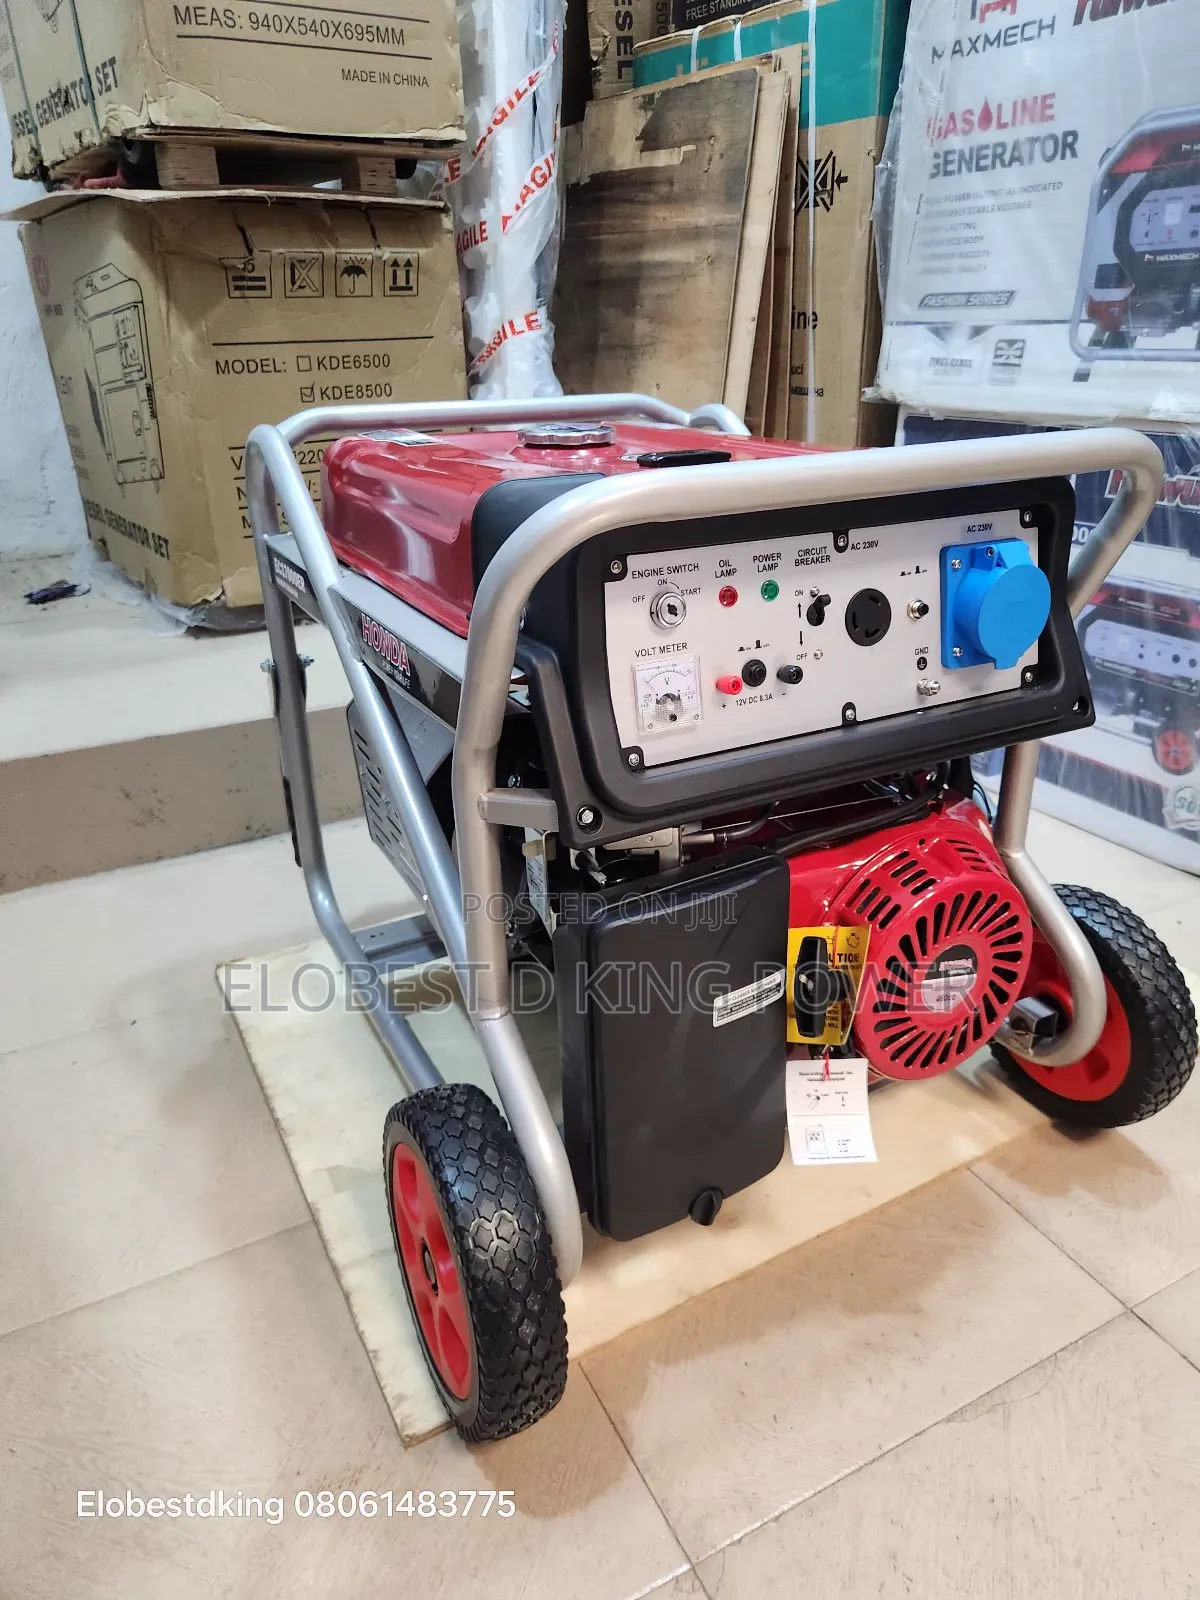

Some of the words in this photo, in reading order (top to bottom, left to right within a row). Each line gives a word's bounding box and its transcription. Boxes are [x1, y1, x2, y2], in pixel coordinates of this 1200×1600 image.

[685, 4, 708, 21] FREE
[173, 5, 243, 30] MEAS:
[248, 11, 405, 46] 940X540X695MM
[931, 15, 1056, 64] MAXMECH
[341, 68, 376, 83] MADE
[378, 72, 391, 85] IN
[393, 73, 429, 88] CHINA
[35, 76, 90, 128] GENERATO
[95, 56, 118, 97] SET
[215, 357, 287, 375] MODEL:
[317, 353, 391, 371] KDE6500
[319, 382, 393, 401] KDE8500
[967, 524, 976, 534] AC
[977, 522, 993, 533] 230V
[151, 531, 171, 561] SET
[850, 541, 861, 551] AC
[862, 539, 880, 549] 230V
[752, 552, 782, 564] POWER
[797, 546, 828, 559] CIRCUIT
[718, 559, 733, 568] OIL
[794, 554, 831, 567] BREAKER
[631, 566, 665, 580] ENGINE
[666, 562, 700, 575] SWITCH
[714, 567, 738, 579] LAMP
[757, 562, 779, 573] LAMP
[657, 578, 668, 586] ON
[680, 587, 702, 597] START
[794, 589, 804, 597] ON
[631, 595, 646, 604] OFF
[361, 612, 412, 677] HONDA
[634, 645, 658, 659] VOLT
[658, 642, 688, 656] METER
[796, 652, 808, 661] OFF
[914, 647, 929, 655] GND
[664, 676, 670, 686] V
[735, 697, 747, 707] 12V
[748, 695, 758, 705] DC
